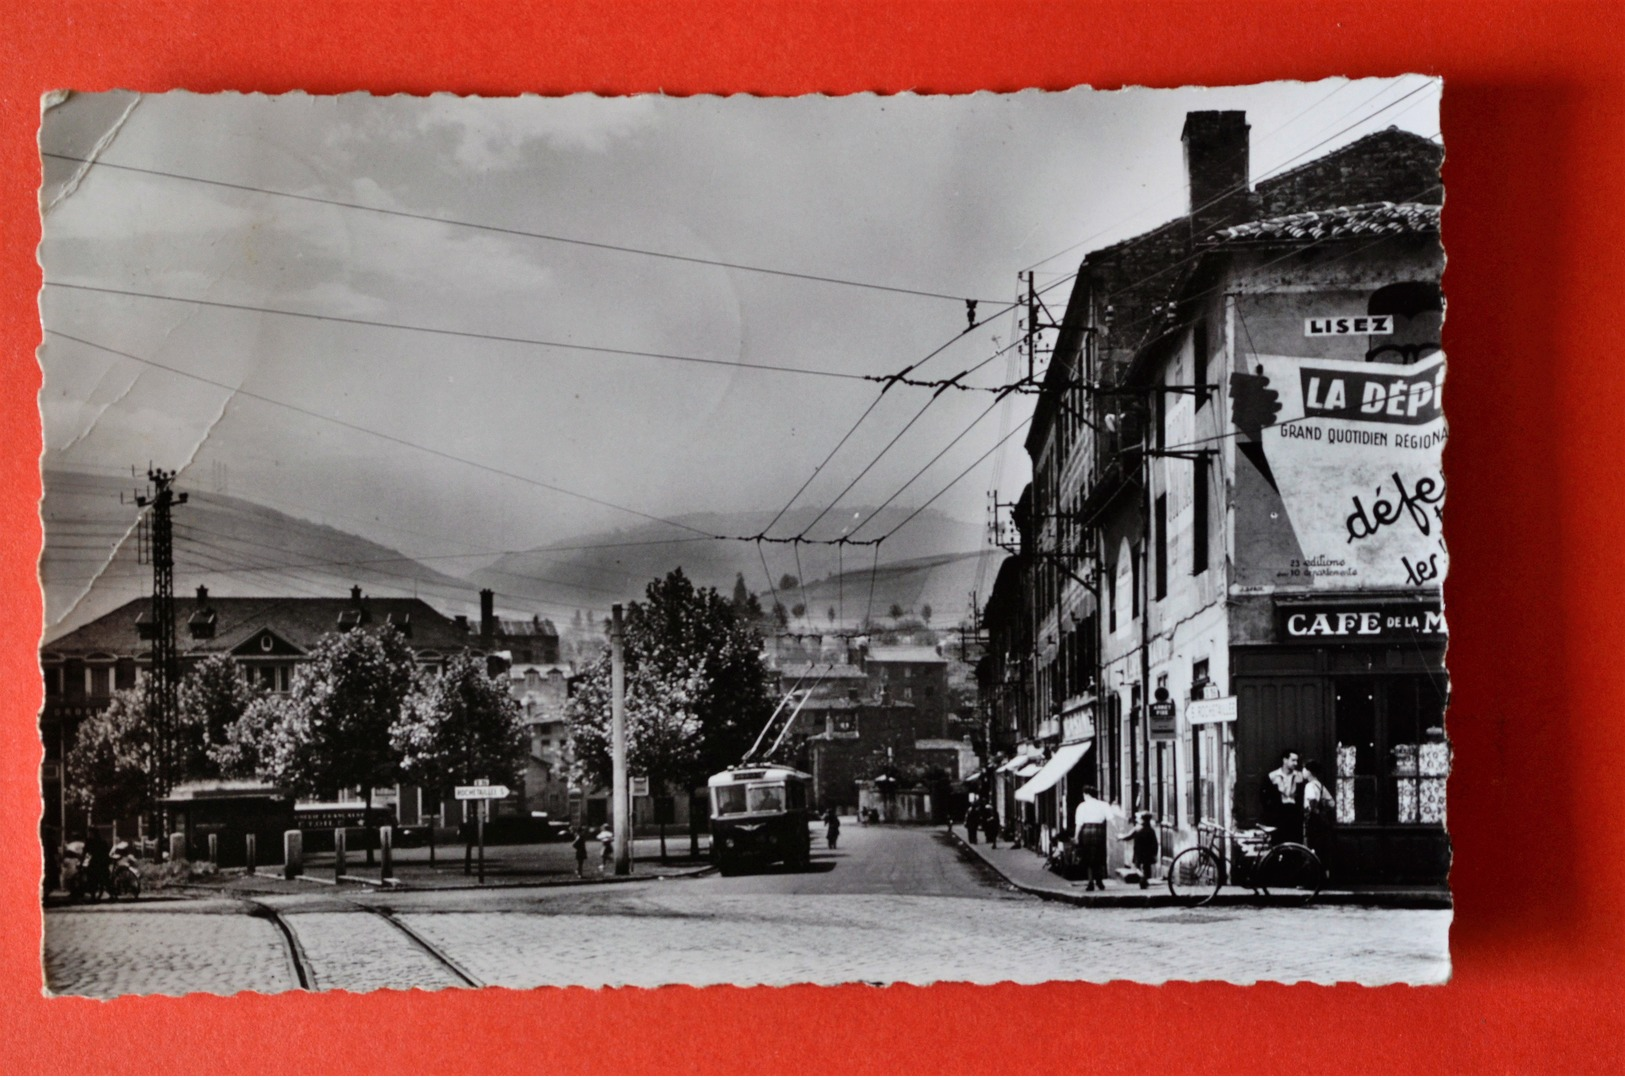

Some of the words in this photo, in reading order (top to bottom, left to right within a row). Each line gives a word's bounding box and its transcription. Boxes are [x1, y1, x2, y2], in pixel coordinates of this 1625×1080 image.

[1310, 317, 1388, 334] LISEZ
[1306, 377, 1346, 410] LA
[1280, 423, 1322, 440] GRAND
[1328, 428, 1388, 446] QUOTIDIEN
[1401, 554, 1438, 586] les
[1287, 612, 1382, 636] CAFE
[1386, 616, 1402, 628] DE
[1404, 616, 1419, 628] LA
